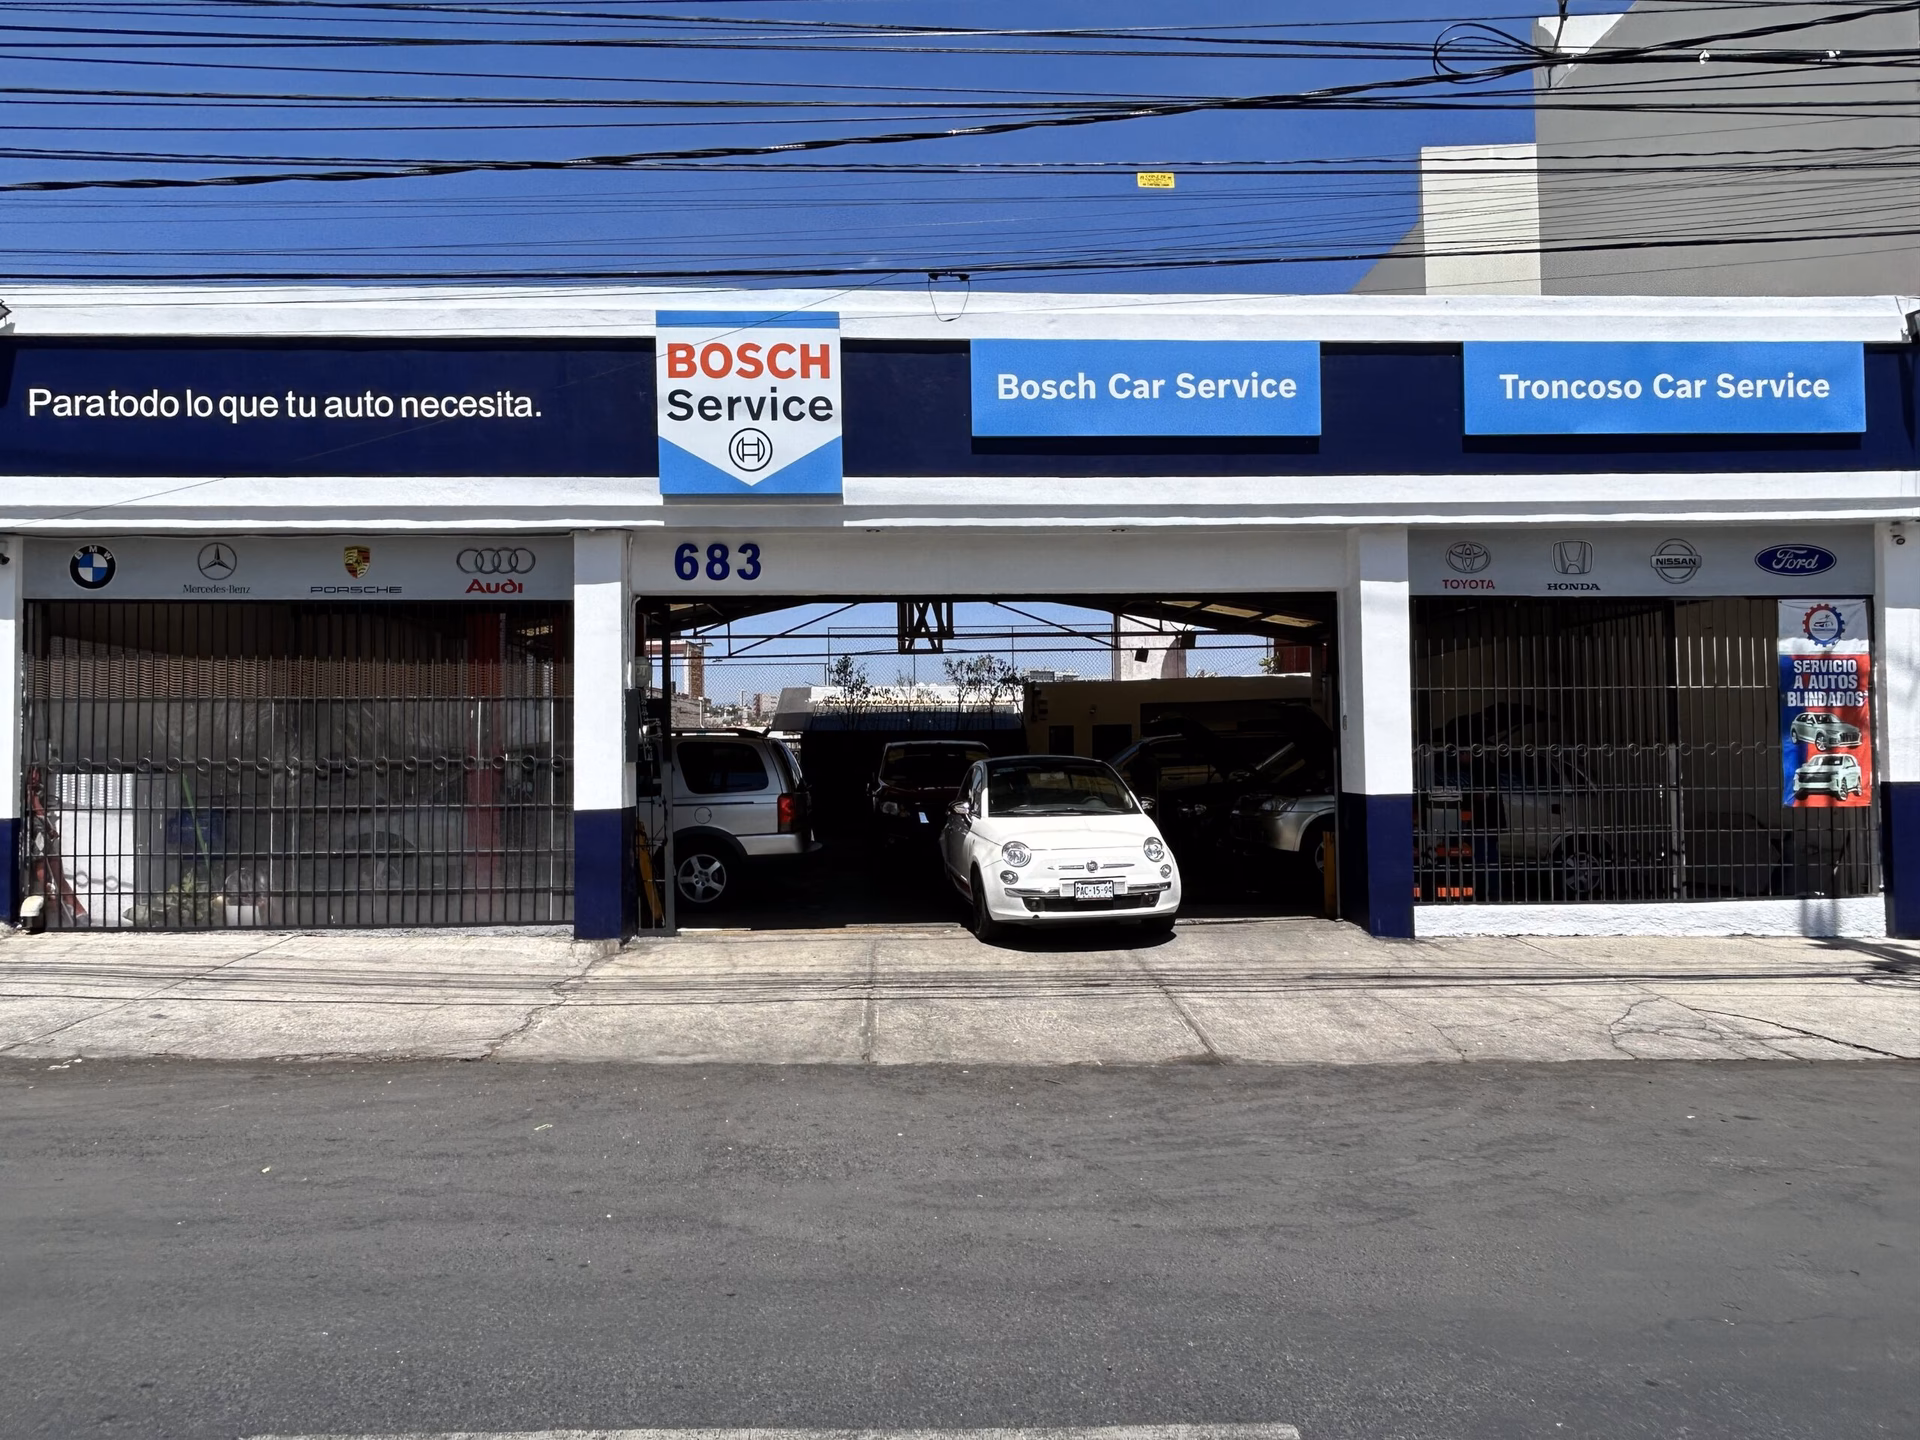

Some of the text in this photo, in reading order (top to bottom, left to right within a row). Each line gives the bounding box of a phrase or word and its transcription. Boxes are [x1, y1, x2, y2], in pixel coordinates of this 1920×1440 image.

[667, 343, 830, 379] BOSCH
[998, 372, 1297, 399] Bosch Car Service
[1499, 372, 1830, 399] Troncoso Car Service
[187, 389, 213, 417] lo
[219, 396, 279, 423] que
[286, 391, 317, 417] tu
[325, 391, 394, 417] auto
[402, 391, 542, 417] necesita.
[667, 387, 833, 421] Service
[74, 545, 113, 560] BMW
[1772, 548, 1819, 570] Ford
[674, 543, 762, 581] 683
[1655, 557, 1697, 566] NISSAN
[183, 584, 251, 594] Mercedes-Benz
[310, 585, 403, 594] PORSCHE
[465, 578, 523, 594] Audi
[1442, 579, 1495, 590] TOYOTA
[1547, 582, 1601, 591] HONDA
[1793, 659, 1857, 673] SERVICIO
[1793, 674, 1858, 690] A AUTOS
